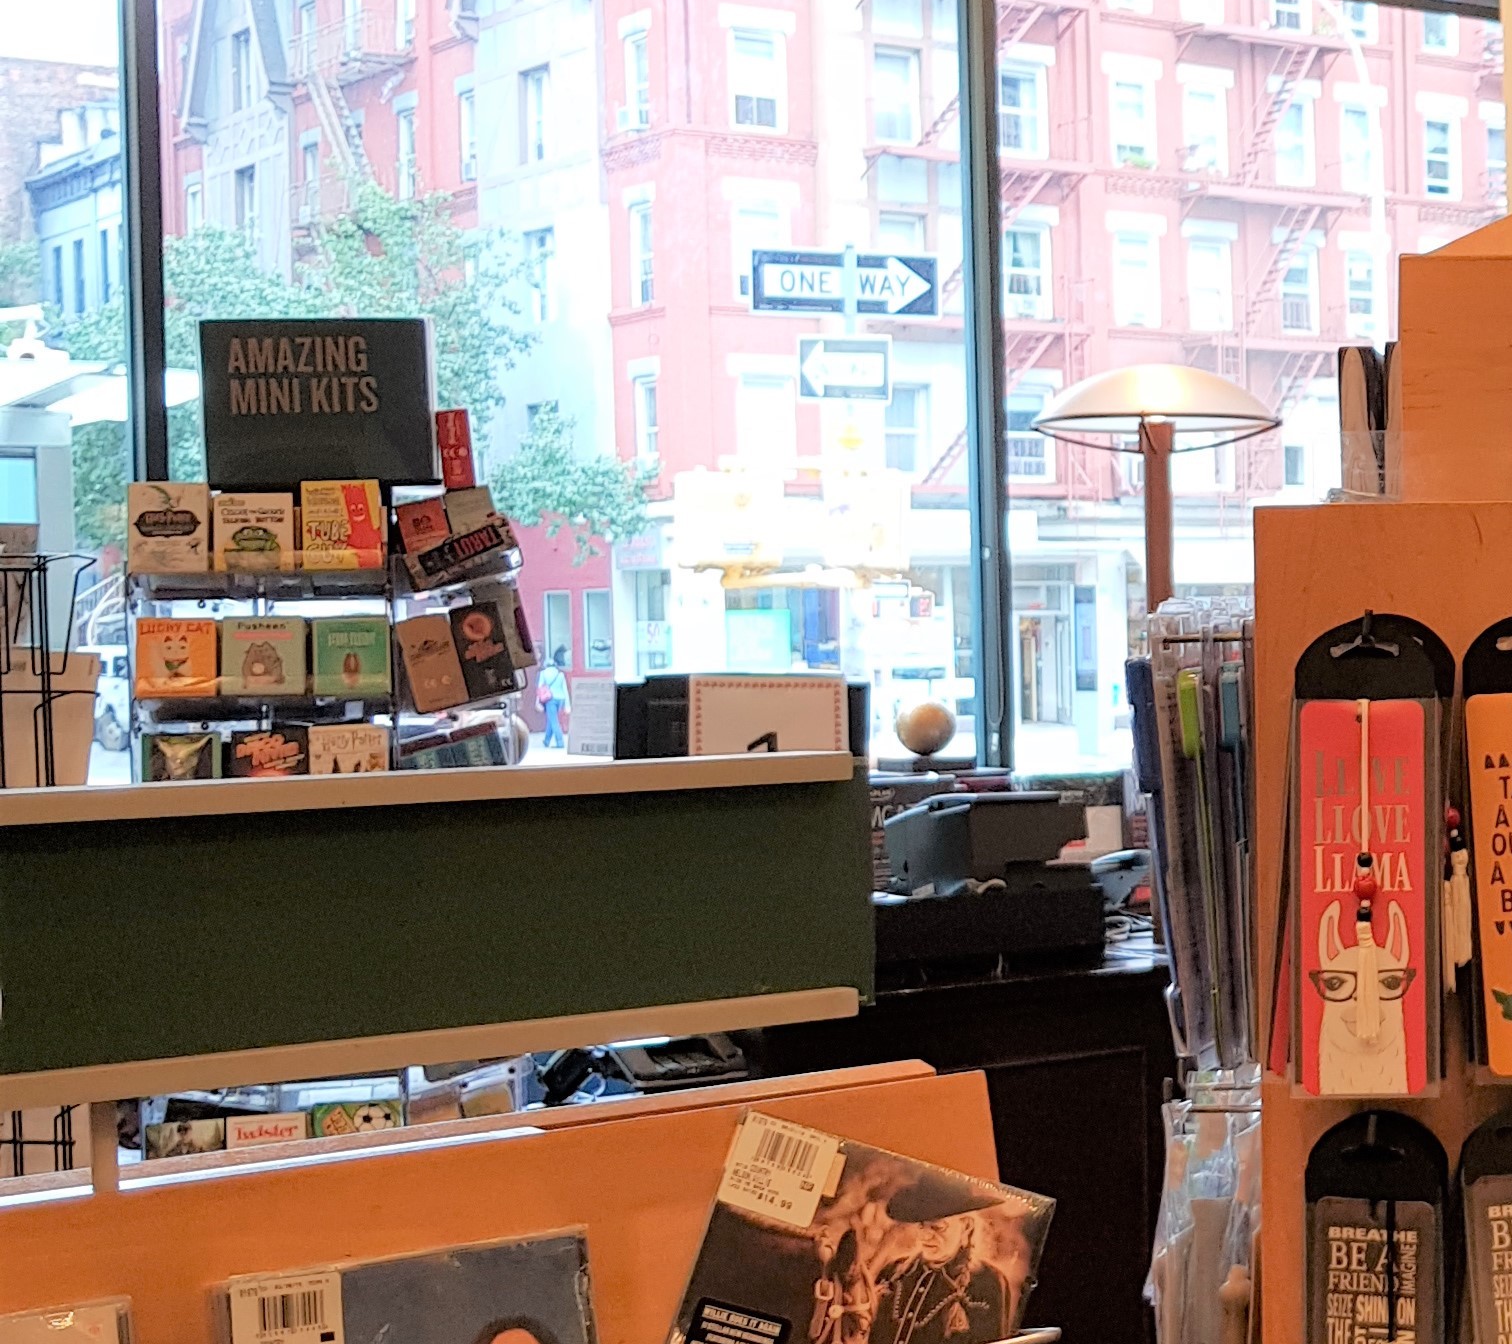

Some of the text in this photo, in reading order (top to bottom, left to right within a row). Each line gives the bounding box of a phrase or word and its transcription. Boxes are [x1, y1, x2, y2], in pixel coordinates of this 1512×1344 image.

[780, 270, 910, 298] ONE WAY
[228, 336, 367, 373] AMAZING
[231, 375, 378, 415] MINI KITS
[308, 521, 348, 541] TUBE
[1495, 805, 1510, 828] A
[1491, 861, 1505, 885] A
